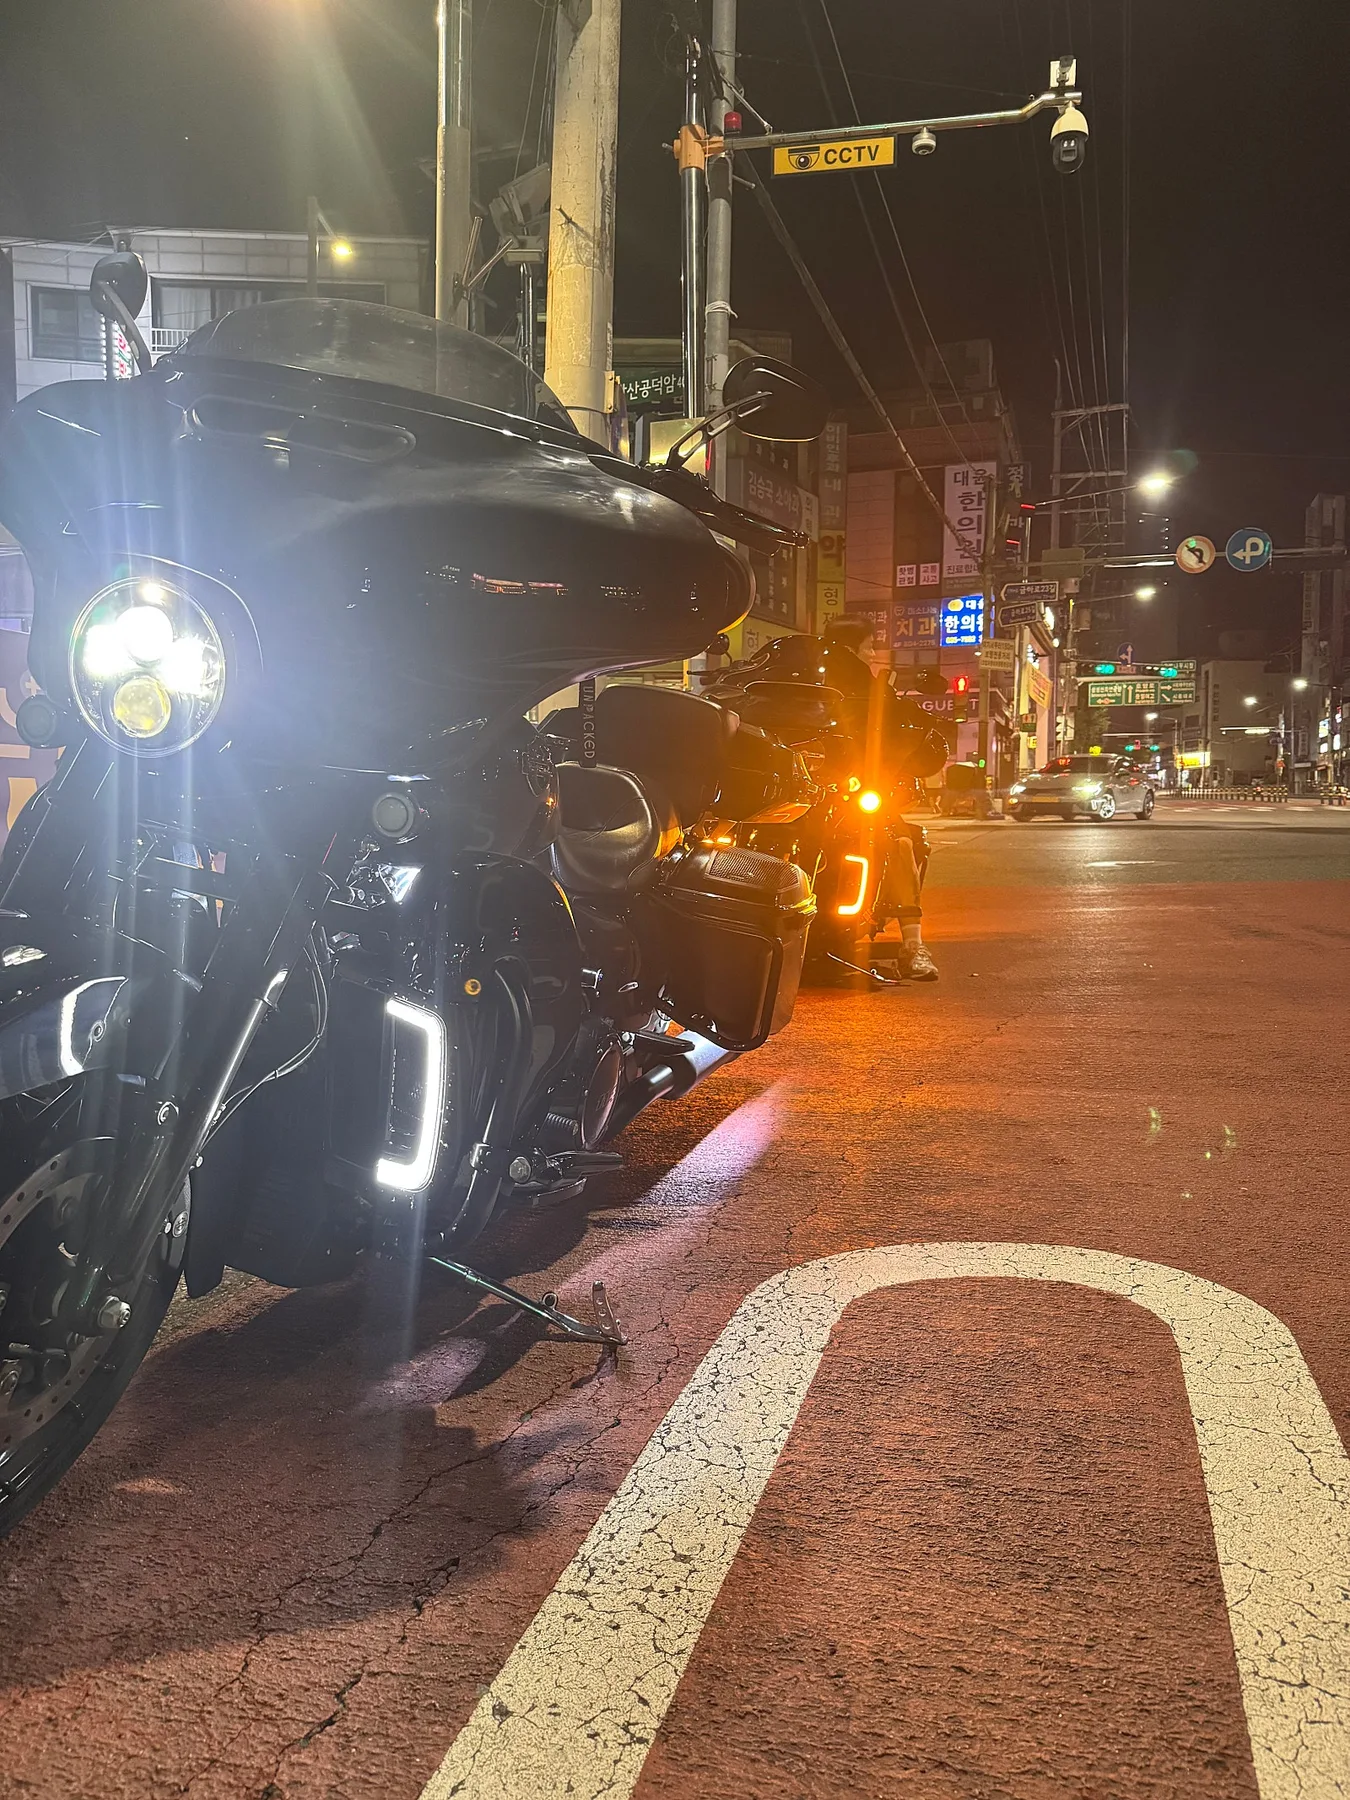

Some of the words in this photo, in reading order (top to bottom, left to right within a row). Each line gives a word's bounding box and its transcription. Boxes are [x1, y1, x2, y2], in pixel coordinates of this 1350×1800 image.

[824, 144, 880, 165] CCTV
[955, 491, 986, 560] 한의원
[896, 616, 938, 637] 치과
[922, 698, 980, 712] GUET
[582, 686, 596, 759] UNPACKED
